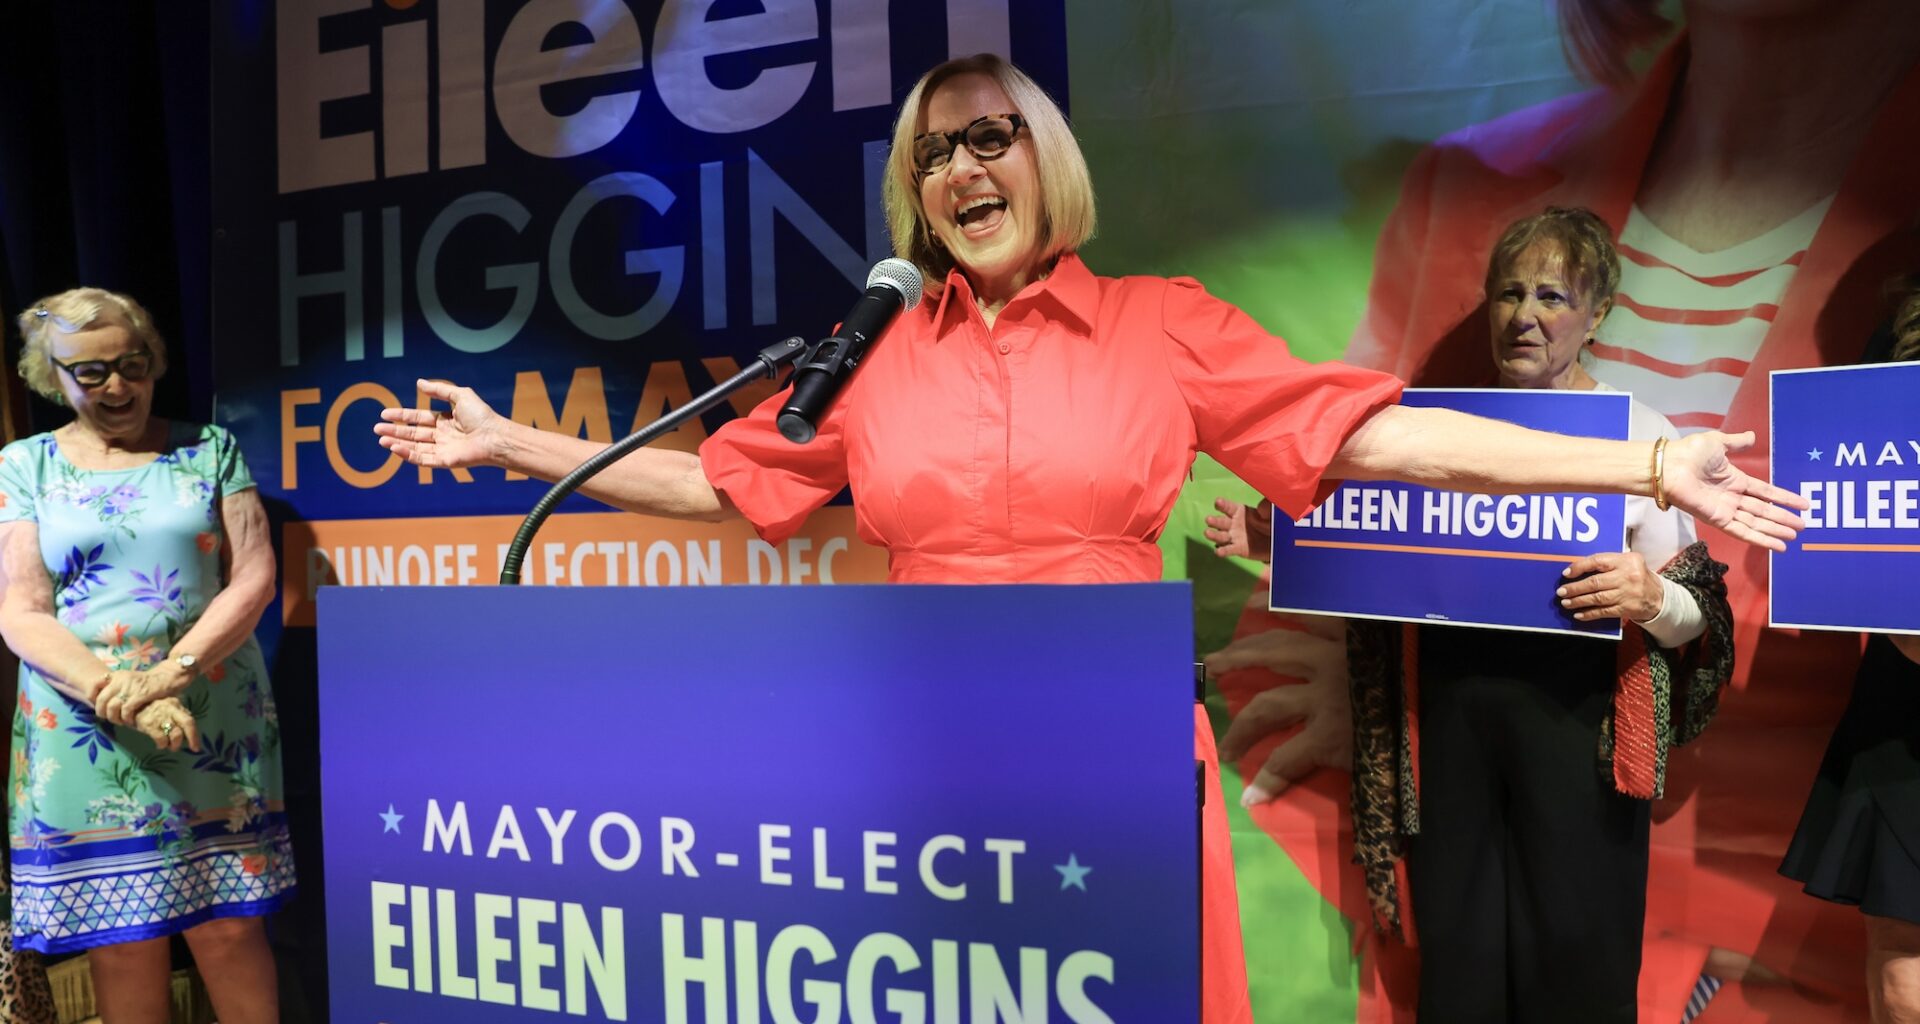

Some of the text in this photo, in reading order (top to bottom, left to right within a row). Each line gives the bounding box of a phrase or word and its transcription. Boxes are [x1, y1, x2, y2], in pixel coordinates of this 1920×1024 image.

[276, 0, 1011, 194] Eileen
[1294, 487, 1599, 543] ILEEN HIGGINS
[422, 798, 1026, 904] MAYOR-ELECT
[371, 880, 1114, 1024] EILEEN HIGGINS
